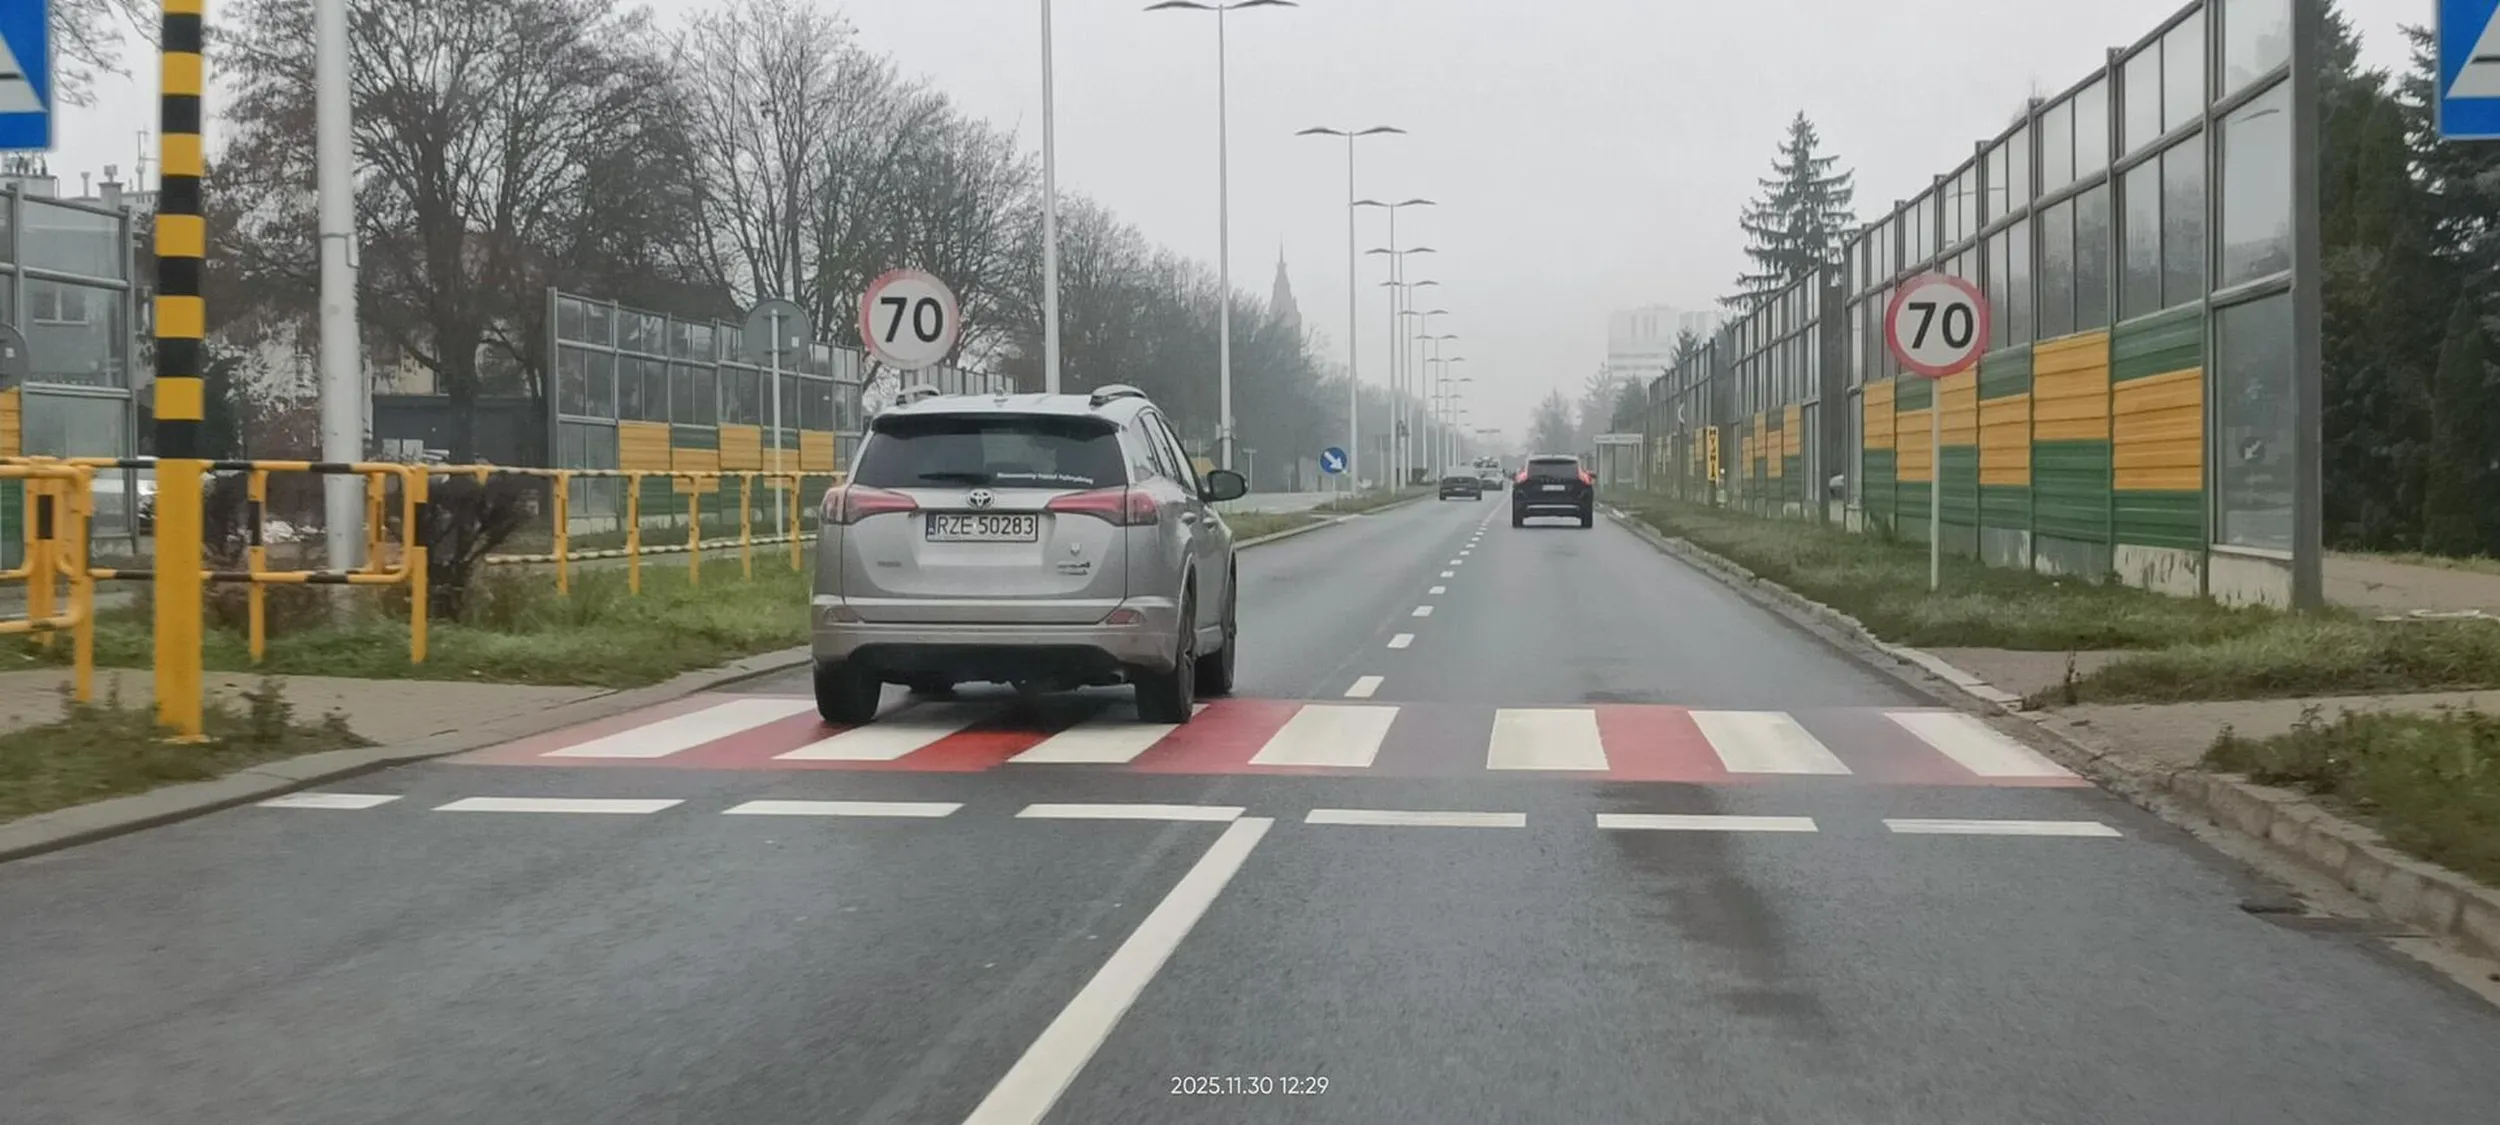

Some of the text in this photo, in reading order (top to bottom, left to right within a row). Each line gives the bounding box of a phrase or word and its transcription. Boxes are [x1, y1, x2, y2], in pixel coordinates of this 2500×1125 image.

[880, 296, 943, 343] 70
[1908, 302, 1974, 349] 70
[937, 516, 1034, 536] RZE 50283
